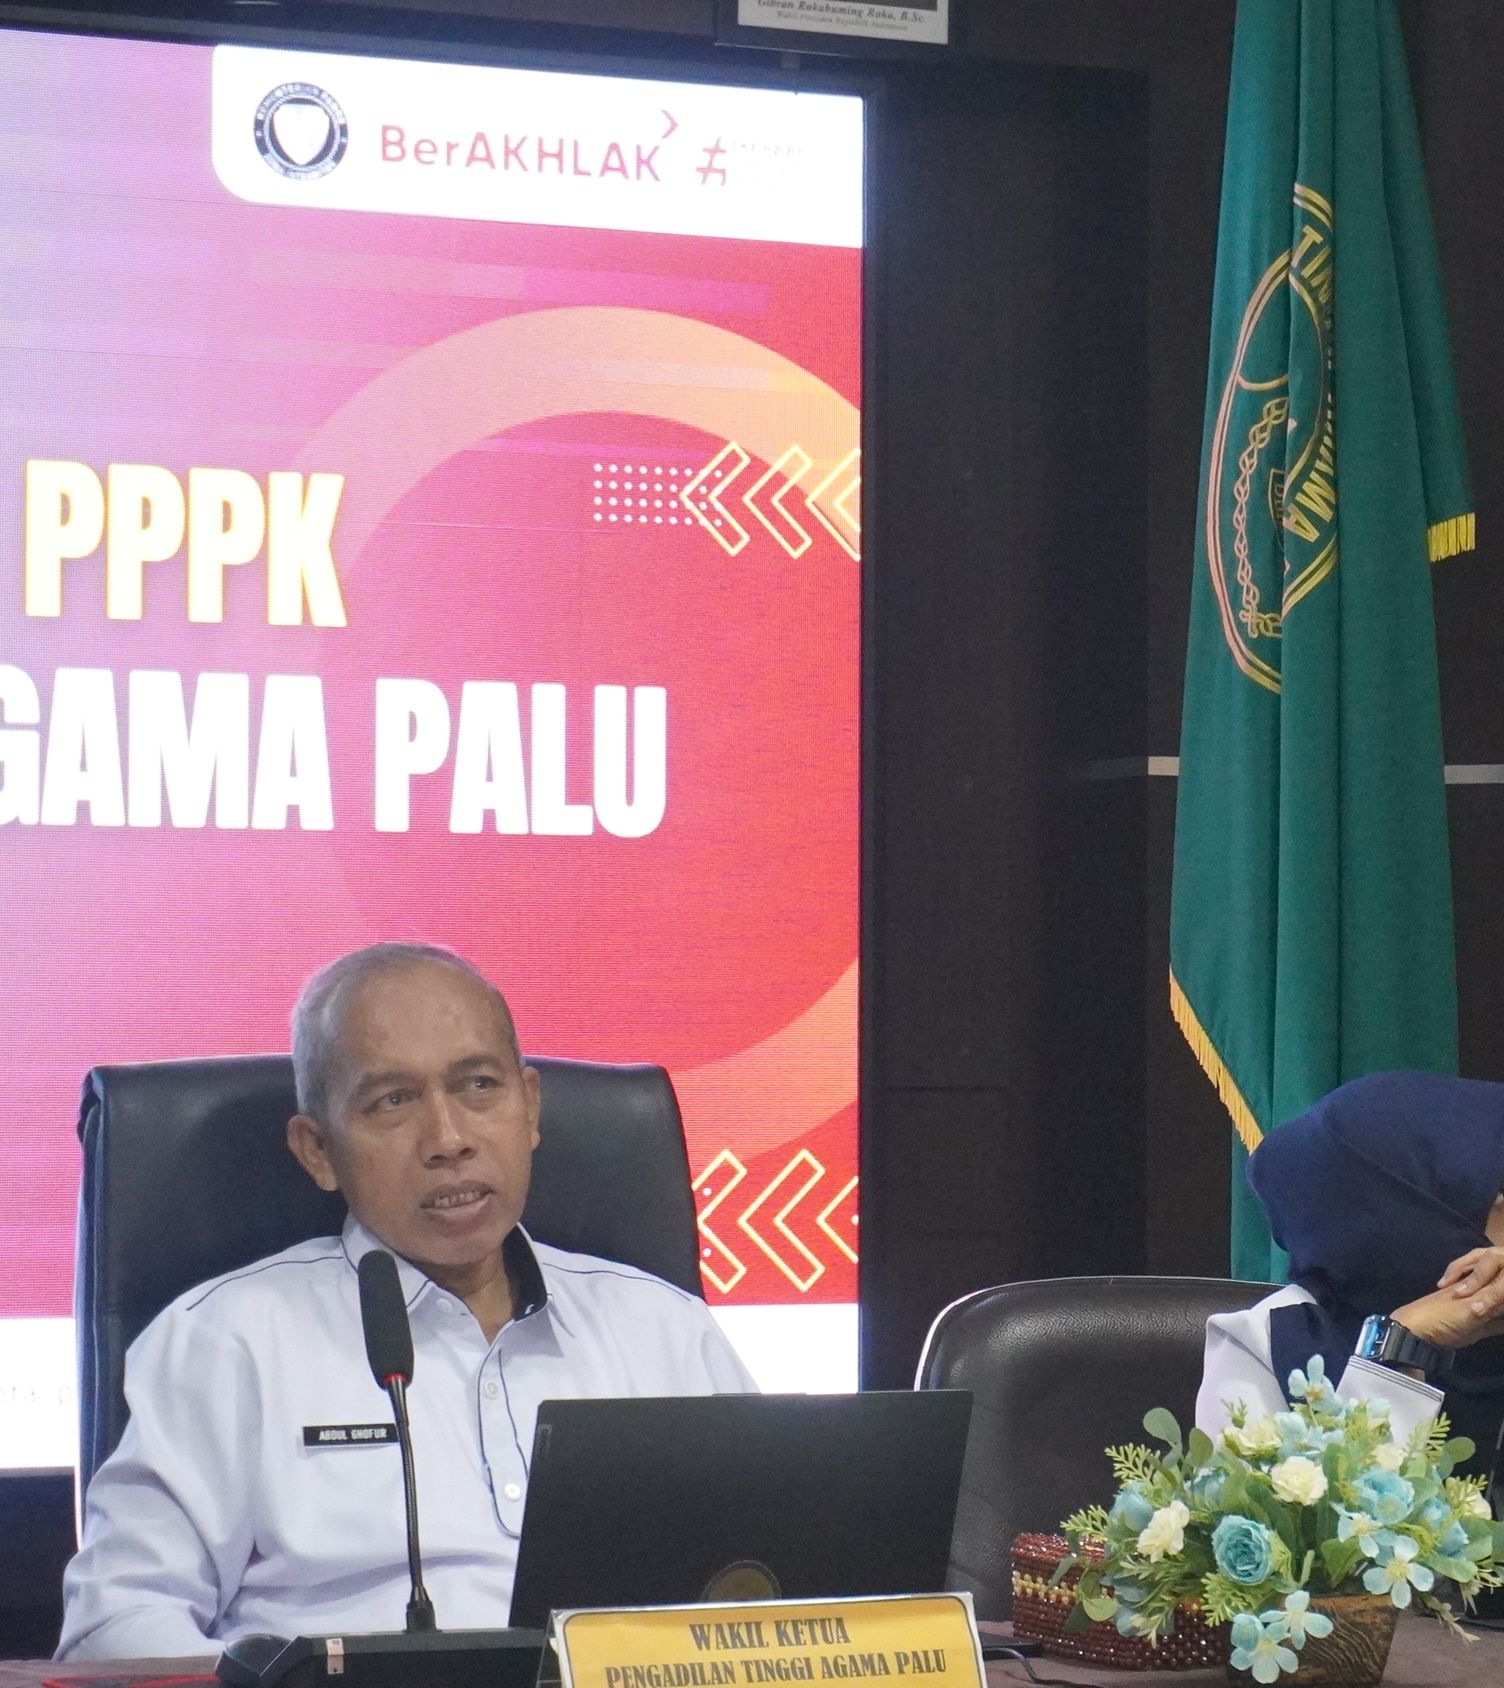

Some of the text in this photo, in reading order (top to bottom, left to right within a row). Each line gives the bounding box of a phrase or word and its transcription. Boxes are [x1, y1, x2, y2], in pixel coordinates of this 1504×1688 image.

[380, 123, 662, 183] BerAKHLAK
[24, 458, 348, 628] PPPK
[374, 677, 668, 838] PALU
[688, 1616, 851, 1651] WAKIL KETUA
[605, 1648, 947, 1688] PENGADILAN TINGGI AGAMA PALU
